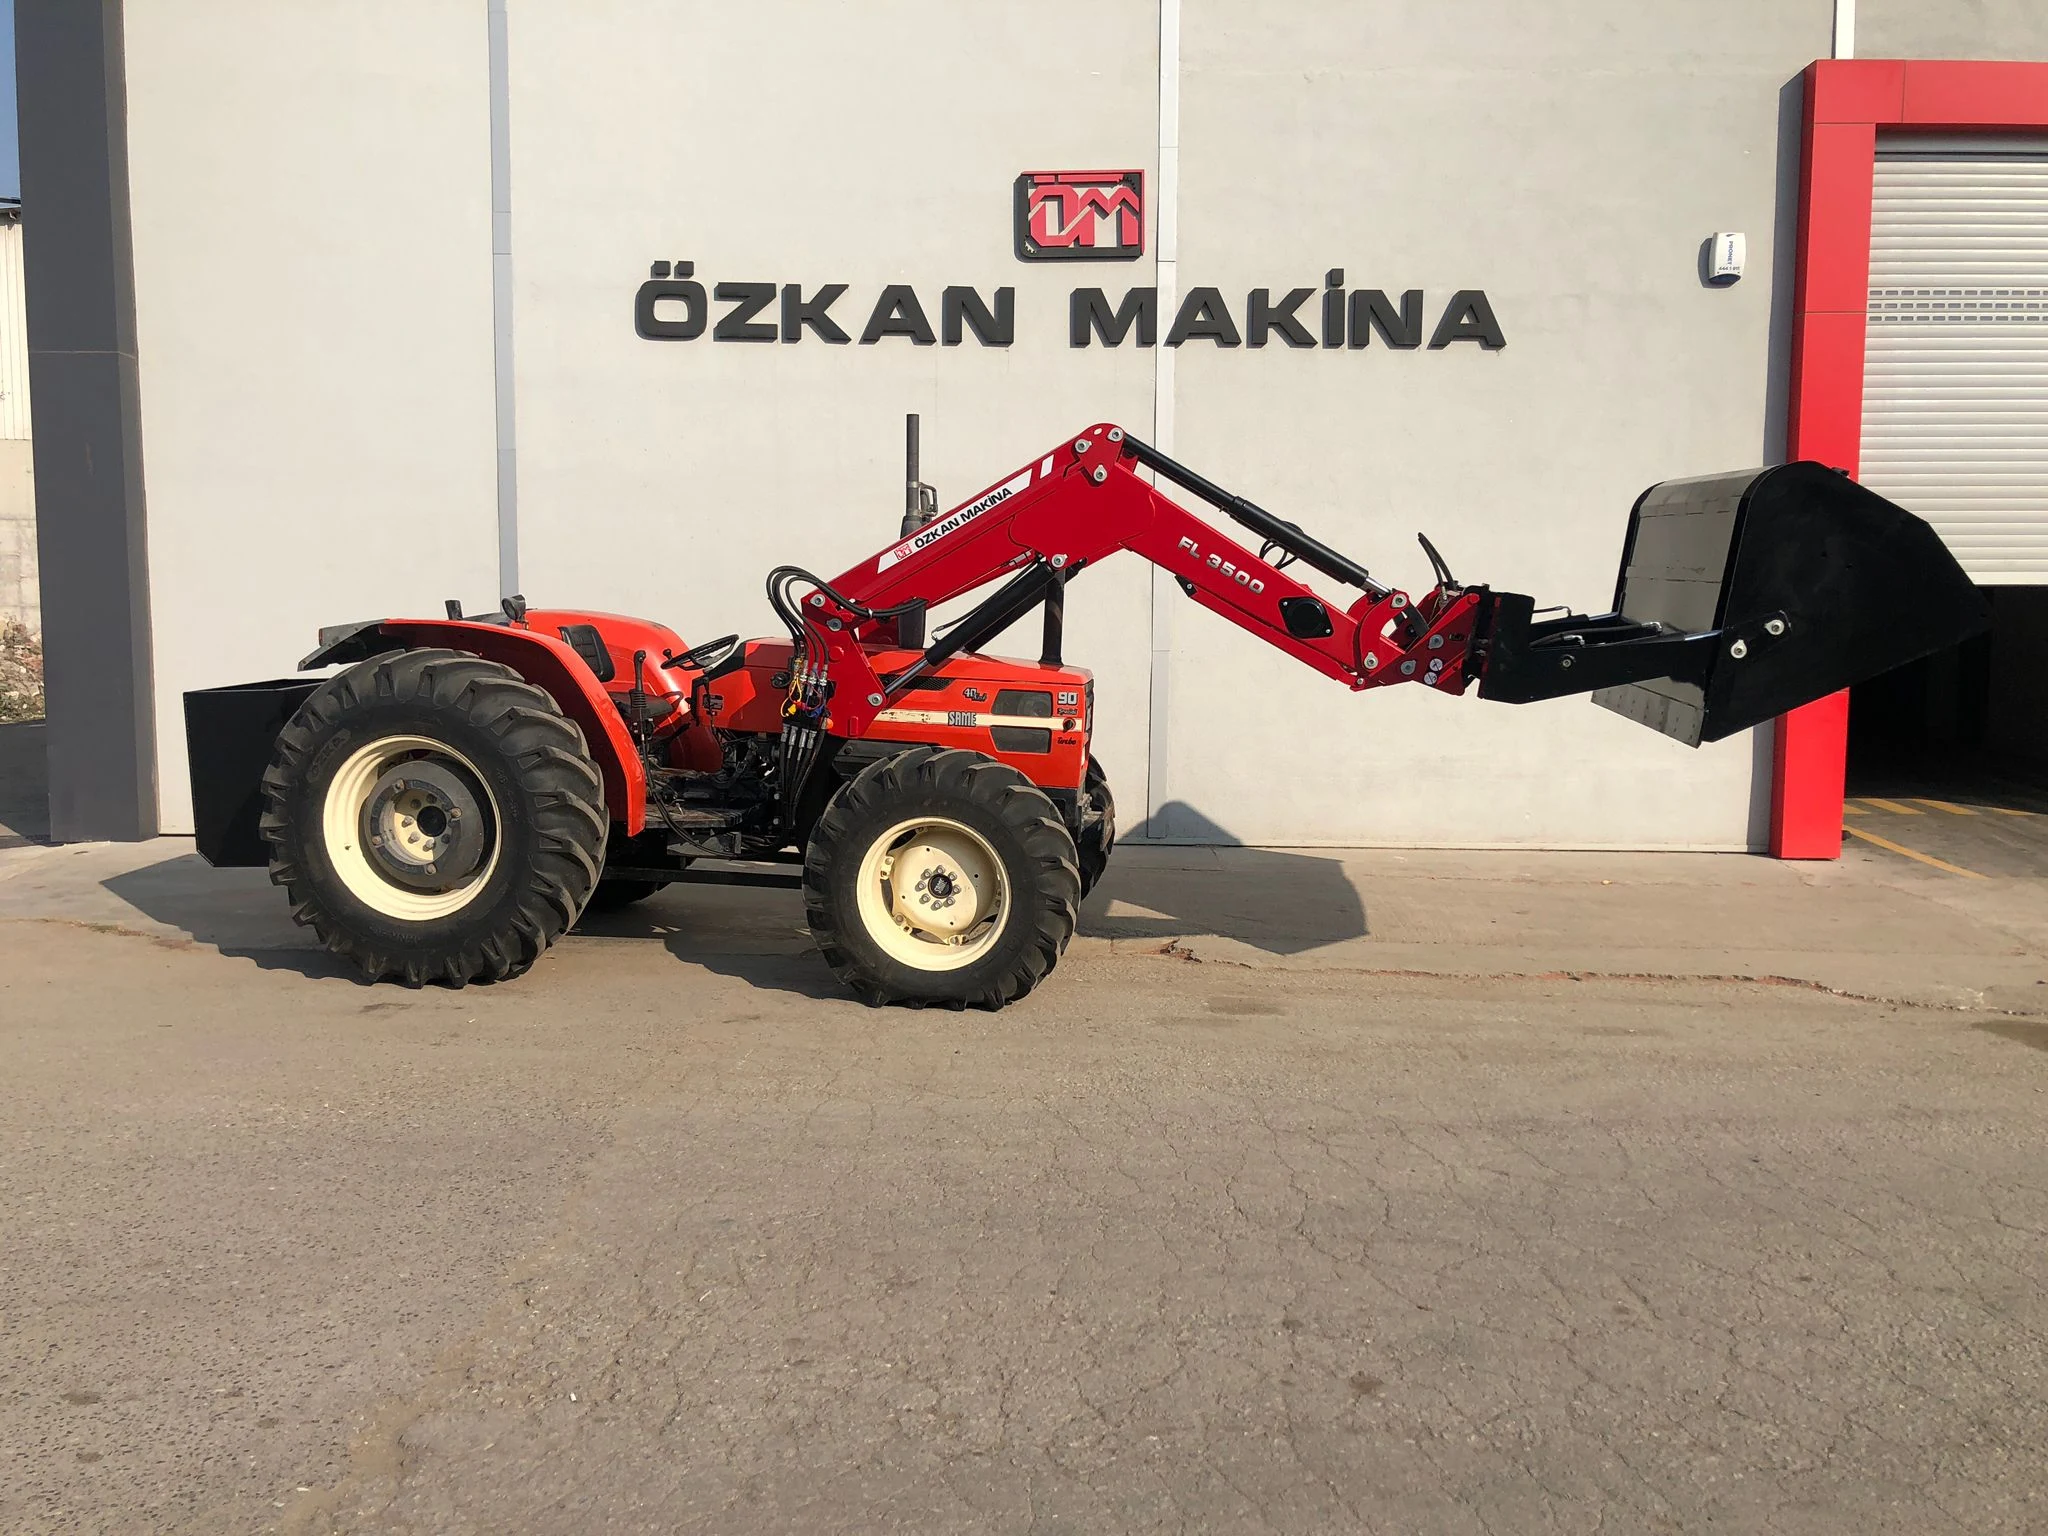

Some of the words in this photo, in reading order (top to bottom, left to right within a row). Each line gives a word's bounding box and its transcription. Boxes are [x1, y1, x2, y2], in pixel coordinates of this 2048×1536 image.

[634, 260, 1015, 346] ÖZKAN
[1070, 268, 1506, 352] MAKİNA
[914, 517, 960, 549] ÖZKAN
[960, 487, 1013, 523] MAKİNA
[1177, 535, 1200, 559] FL
[1206, 553, 1265, 594] 3500
[948, 711, 977, 727] SAME
[1057, 691, 1078, 705] 90
